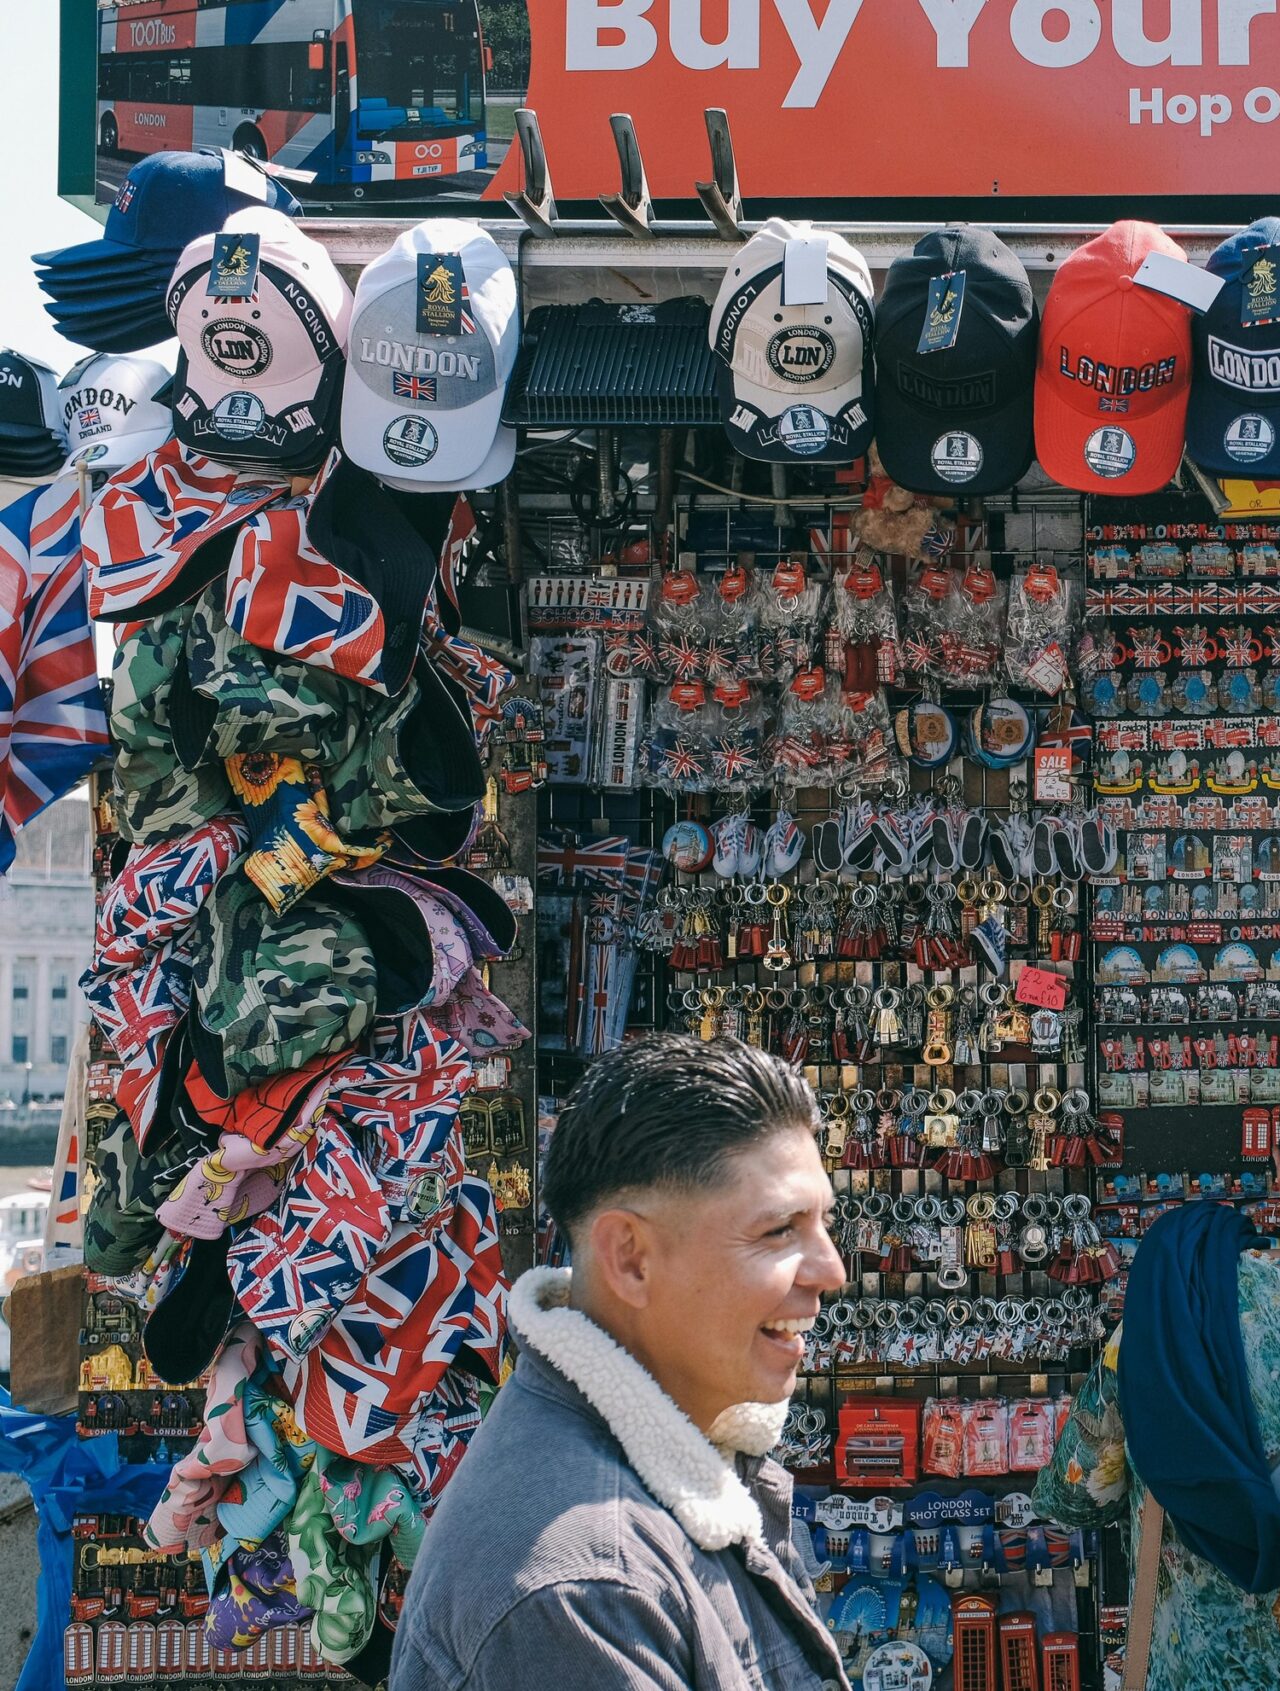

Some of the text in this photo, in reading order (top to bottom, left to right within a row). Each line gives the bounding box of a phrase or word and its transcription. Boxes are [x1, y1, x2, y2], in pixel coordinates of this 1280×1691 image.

[565, 0, 866, 108] Buy
[911, 0, 1277, 68] Your
[1130, 87, 1234, 136] Hop
[134, 112, 167, 128] LONDON
[1247, 300, 1278, 310] STALLION
[1251, 295, 1273, 303] ROYAL
[284, 281, 330, 353] LONDON
[422, 311, 456, 319] STALLION
[720, 285, 757, 352] LONDON
[213, 321, 246, 332] LONDON
[788, 328, 820, 338] LONDON
[214, 339, 254, 361] LDN
[254, 334, 268, 365] LONDON
[769, 339, 781, 368] LONDON
[783, 345, 822, 366] LDN
[824, 340, 836, 370] LONDON
[360, 337, 481, 381] LONDON
[783, 372, 817, 381] LONDON
[1060, 345, 1176, 396] LONDON
[901, 375, 993, 408] LONDON
[64, 387, 138, 432] LONDON
[233, 418, 256, 426] STALLION
[79, 423, 112, 440] ENGLAND
[193, 418, 287, 446] LOON
[803, 430, 827, 438] STALLION
[389, 438, 430, 456] ROYAL STALLION
[1089, 452, 1129, 465] ROYAL STALLION
[530, 607, 644, 626] SCHOOL KIT
[612, 722, 627, 763] LONDON
[1040, 756, 1068, 769] SALE
[1056, 788, 1069, 798] £5
[1022, 969, 1042, 985] £2
[1020, 986, 1029, 1000] 6
[1040, 990, 1058, 1007] £10
[78, 1328, 140, 1345] LONDON
[153, 1427, 189, 1436] LONDON
[910, 1506, 991, 1520] SHOT GLASS SET
[928, 1500, 972, 1510] LONDON
[839, 1511, 879, 1524] London
[66, 1674, 93, 1684] LONDON
[97, 1673, 124, 1682] LONDON
[126, 1673, 154, 1682] LONDON
[155, 1672, 182, 1682] LONDON
[214, 1672, 241, 1680] LONDON
[242, 1671, 269, 1680] LONDON
